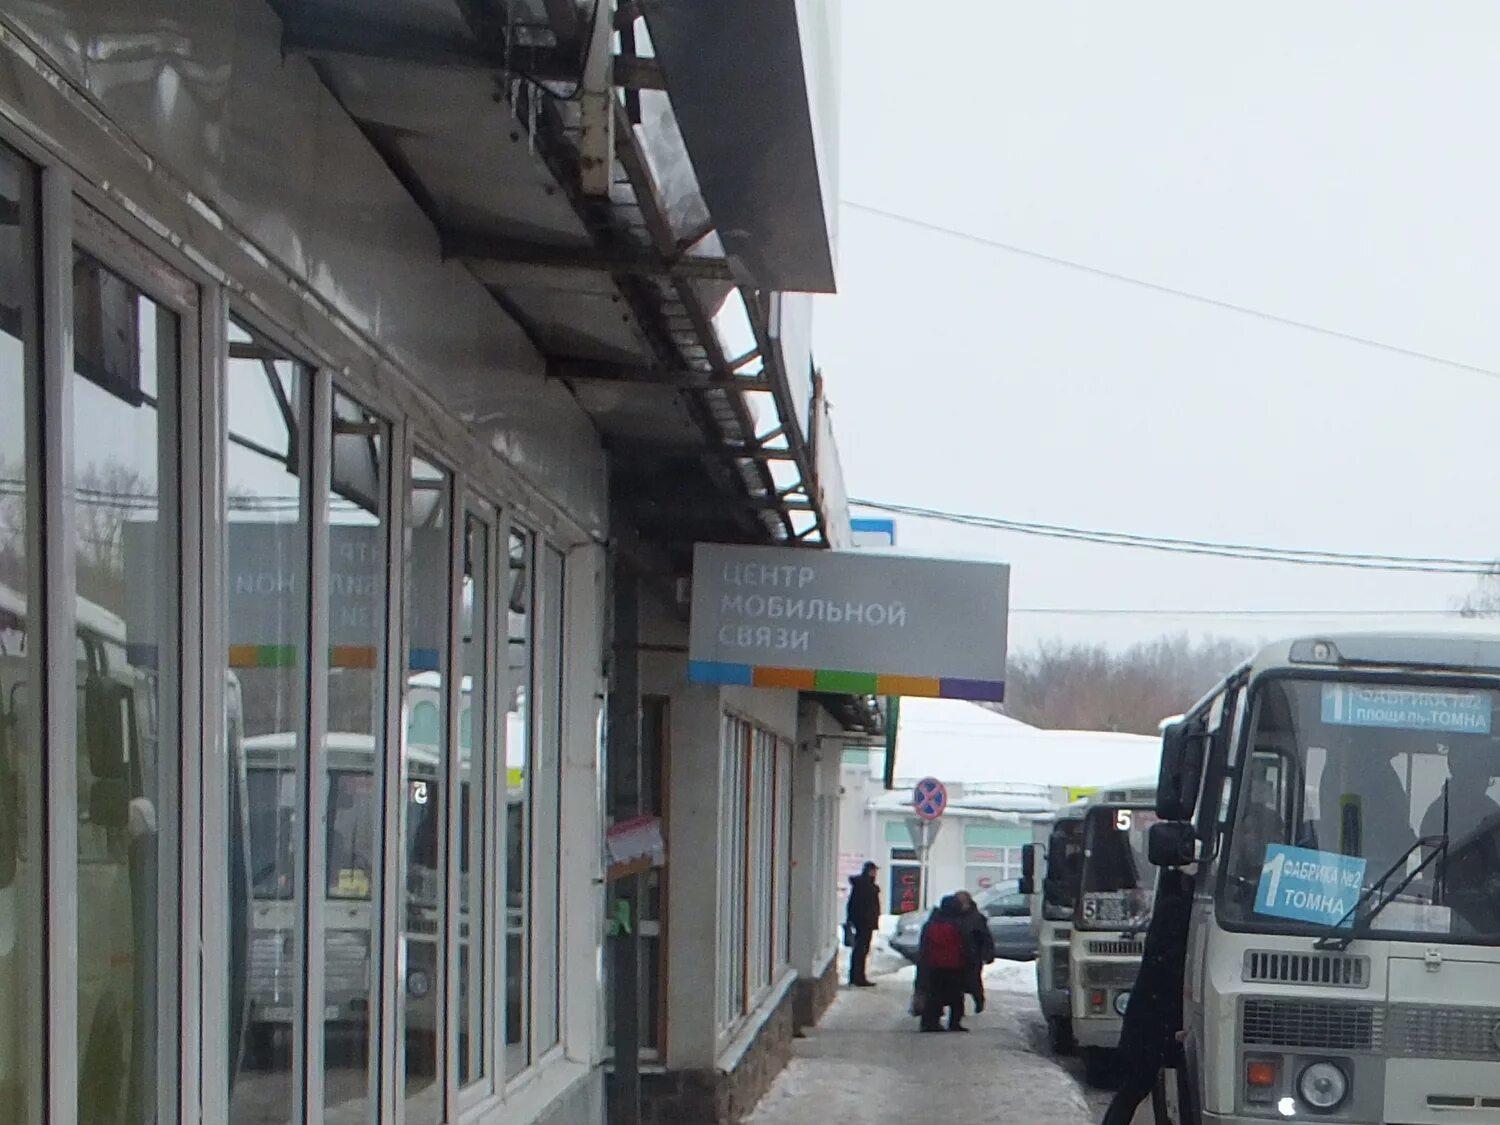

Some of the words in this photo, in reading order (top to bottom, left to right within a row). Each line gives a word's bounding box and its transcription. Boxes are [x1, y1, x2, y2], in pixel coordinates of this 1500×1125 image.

[722, 562, 815, 588] ЦЕНТР
[720, 593, 907, 627] МОБИЛЬНОЙ
[718, 623, 810, 651] СВЯЗИ
[1116, 809, 1132, 831] 5
[1261, 852, 1286, 907] 1
[1283, 860, 1339, 885] ФАБРИКА
[1284, 889, 1345, 915] ТОМНА
